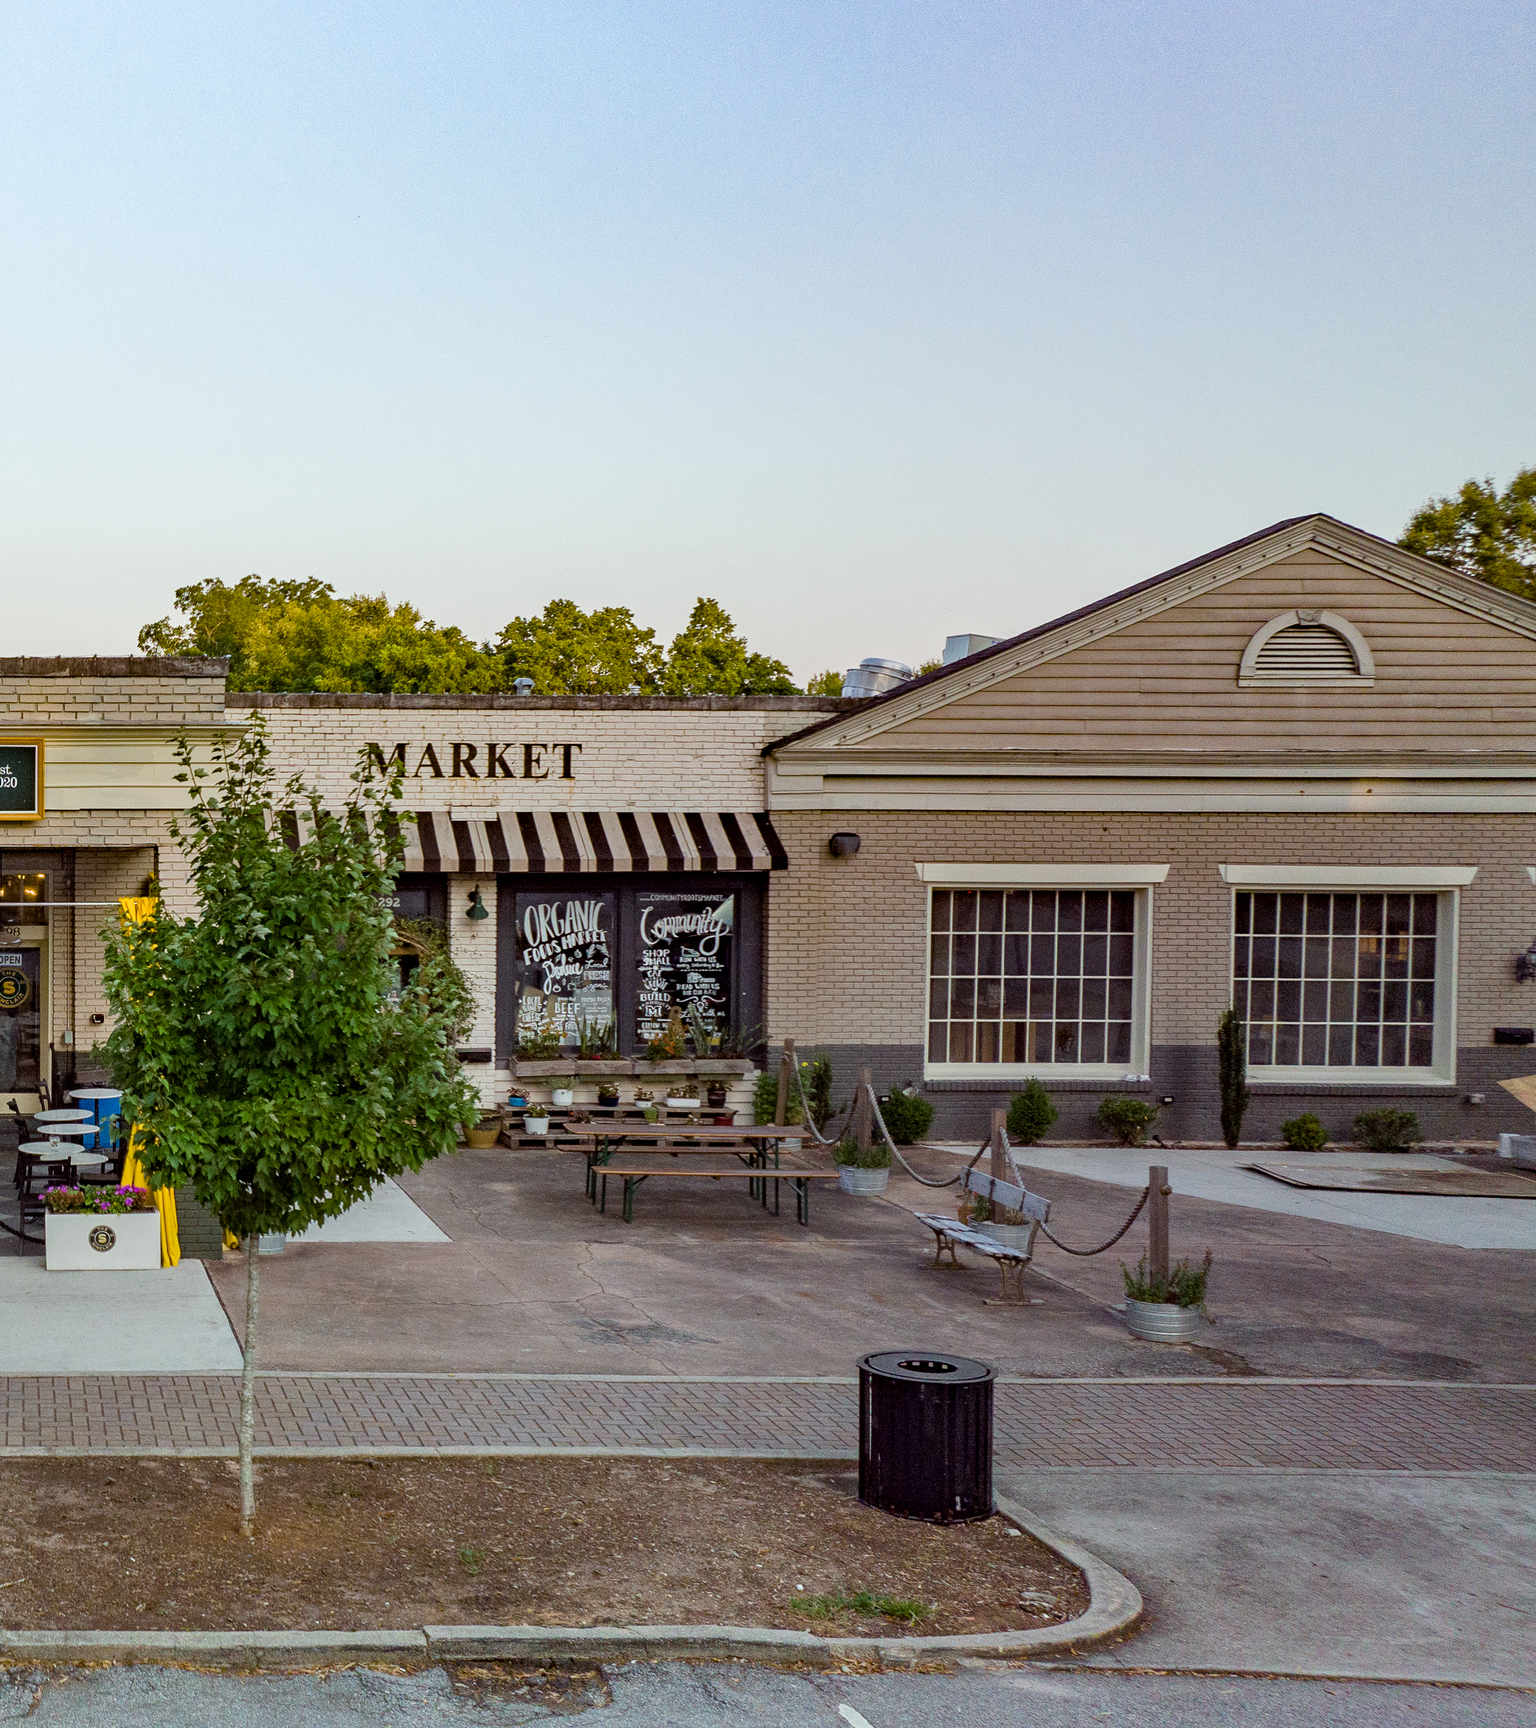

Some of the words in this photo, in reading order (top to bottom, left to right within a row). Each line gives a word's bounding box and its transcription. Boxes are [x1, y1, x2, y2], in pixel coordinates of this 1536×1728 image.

[364, 742, 583, 779] MARKET
[378, 897, 401, 908] 292
[524, 900, 606, 947] ORGANIC
[640, 906, 730, 956] Community
[523, 940, 562, 966] FOODS
[561, 930, 608, 950] MARKET
[643, 949, 670, 957] SHOP
[642, 957, 671, 966] SMALL
[2, 980, 16, 995] S
[640, 993, 671, 1001] BUILD
[554, 1003, 581, 1014] BEEF
[98, 1233, 107, 1244] S
